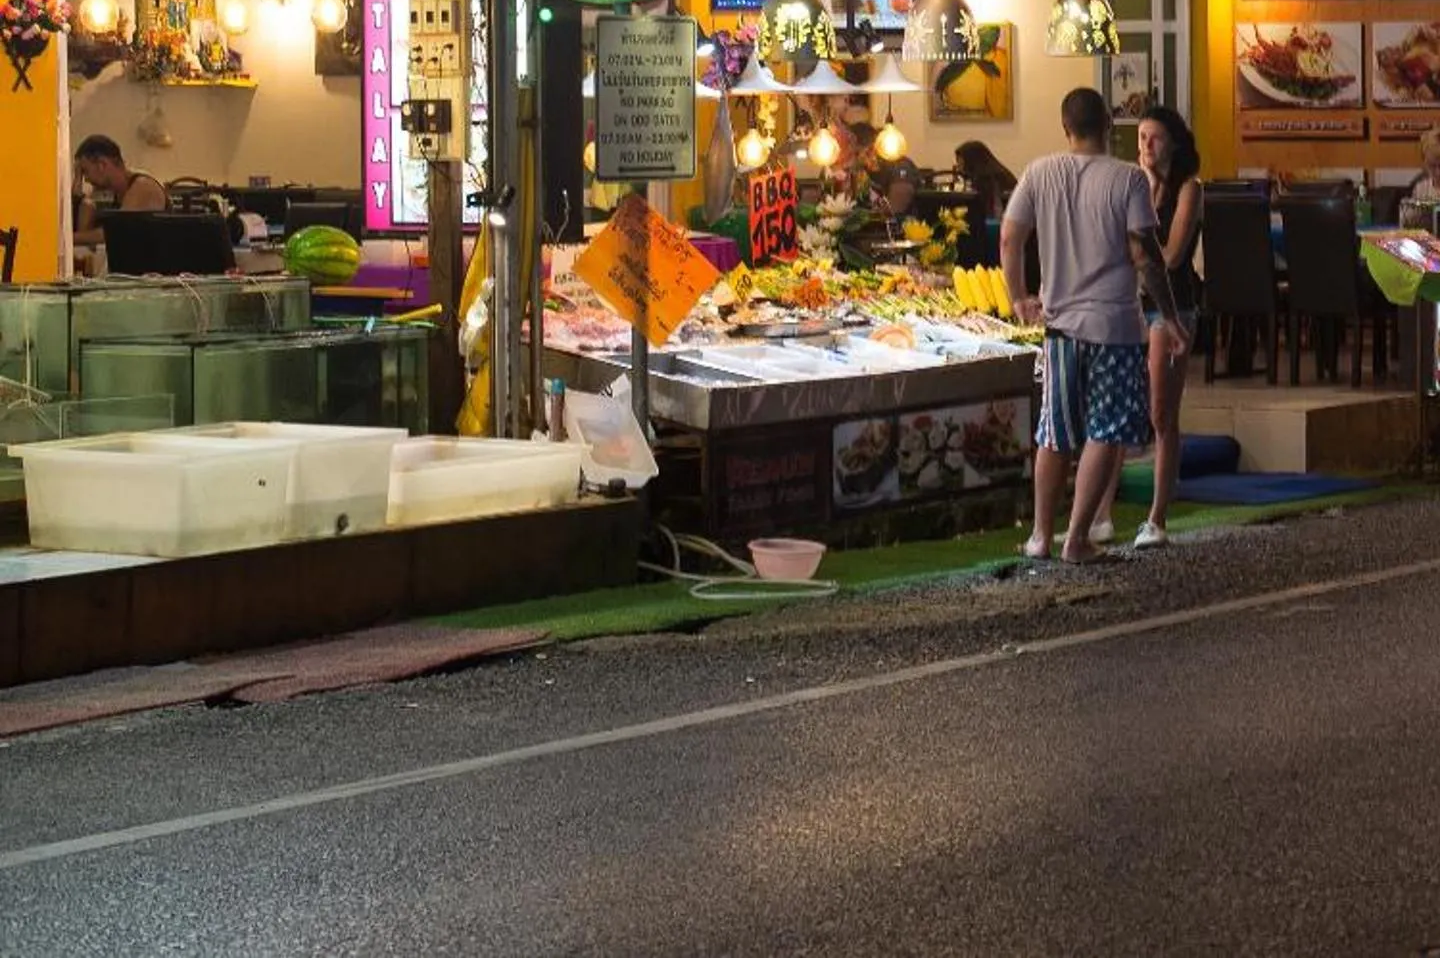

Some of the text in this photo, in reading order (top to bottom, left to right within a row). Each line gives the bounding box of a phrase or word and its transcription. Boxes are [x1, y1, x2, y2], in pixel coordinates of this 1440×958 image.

[620, 97, 634, 108] NO
[619, 150, 674, 163] NO HOLIDAY
[753, 172, 793, 212] BBQ
